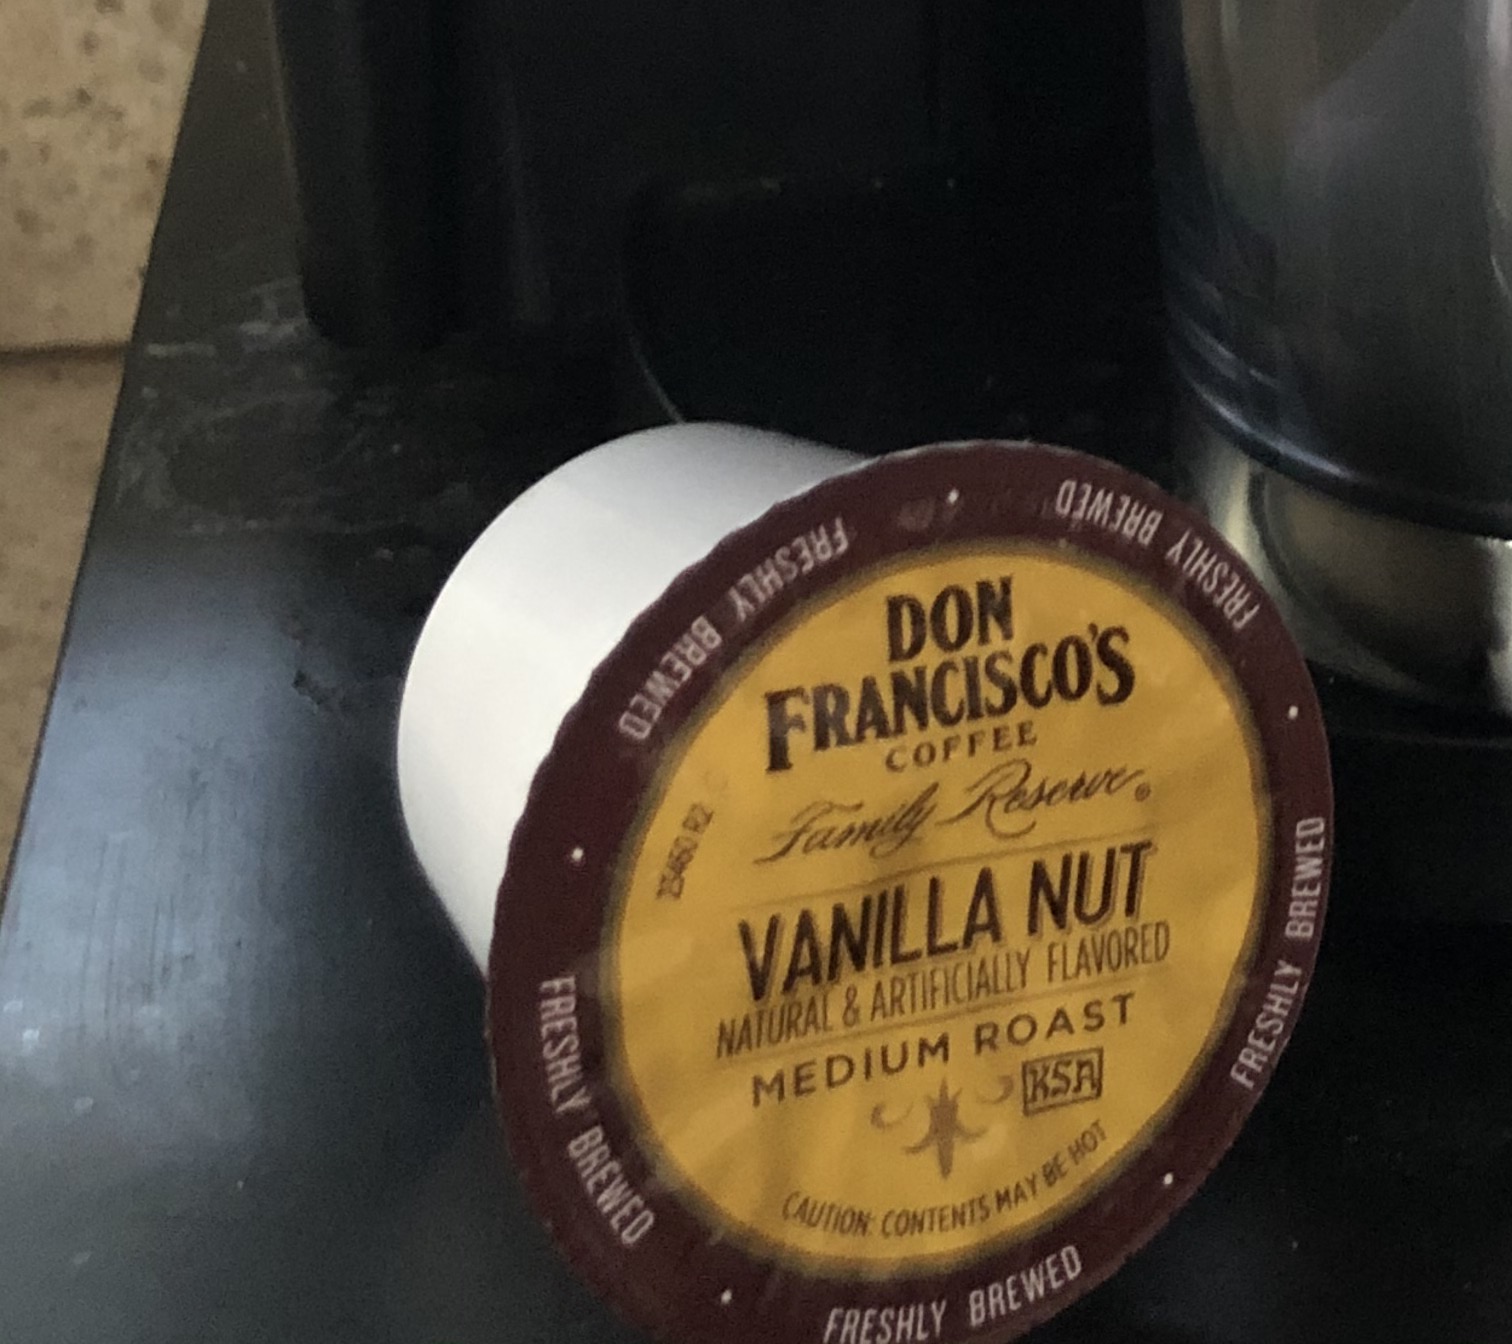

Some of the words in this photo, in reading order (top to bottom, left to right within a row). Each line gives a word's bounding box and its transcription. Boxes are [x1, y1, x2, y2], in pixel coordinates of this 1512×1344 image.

[1055, 480, 1163, 547] BREWED
[727, 517, 849, 622] FRESHLY
[886, 575, 1014, 663] DON
[1164, 527, 1260, 632] FRESHLY
[618, 615, 723, 740] BREWED
[764, 623, 1135, 774] FRANCISCO'S
[886, 720, 1037, 773] COFFEE
[753, 782, 939, 865] Family
[738, 866, 1003, 1002] VANILLA
[1027, 840, 1157, 937] NUT
[1230, 960, 1302, 1090] FRESHLY
[1285, 816, 1325, 939] BREWED
[716, 995, 834, 1059] NATURAL
[841, 987, 861, 1028] &
[871, 945, 1032, 1022] ARTIFICIALLY
[1047, 920, 1170, 984] FLAVORED
[751, 1033, 949, 1108] MEDIUM
[974, 992, 1135, 1055] ROAST
[1027, 1060, 1099, 1102] KSA
[540, 975, 593, 1115] FRESHLY
[567, 1124, 655, 1244] BREWED
[881, 1193, 990, 1238] CONTENTS
[994, 1173, 1038, 1213] MAY
[1041, 1151, 1069, 1188] BE
[1067, 1119, 1107, 1166] HOT
[822, 1300, 947, 1344] FRESHLY
[968, 1245, 1083, 1327] BREWED
